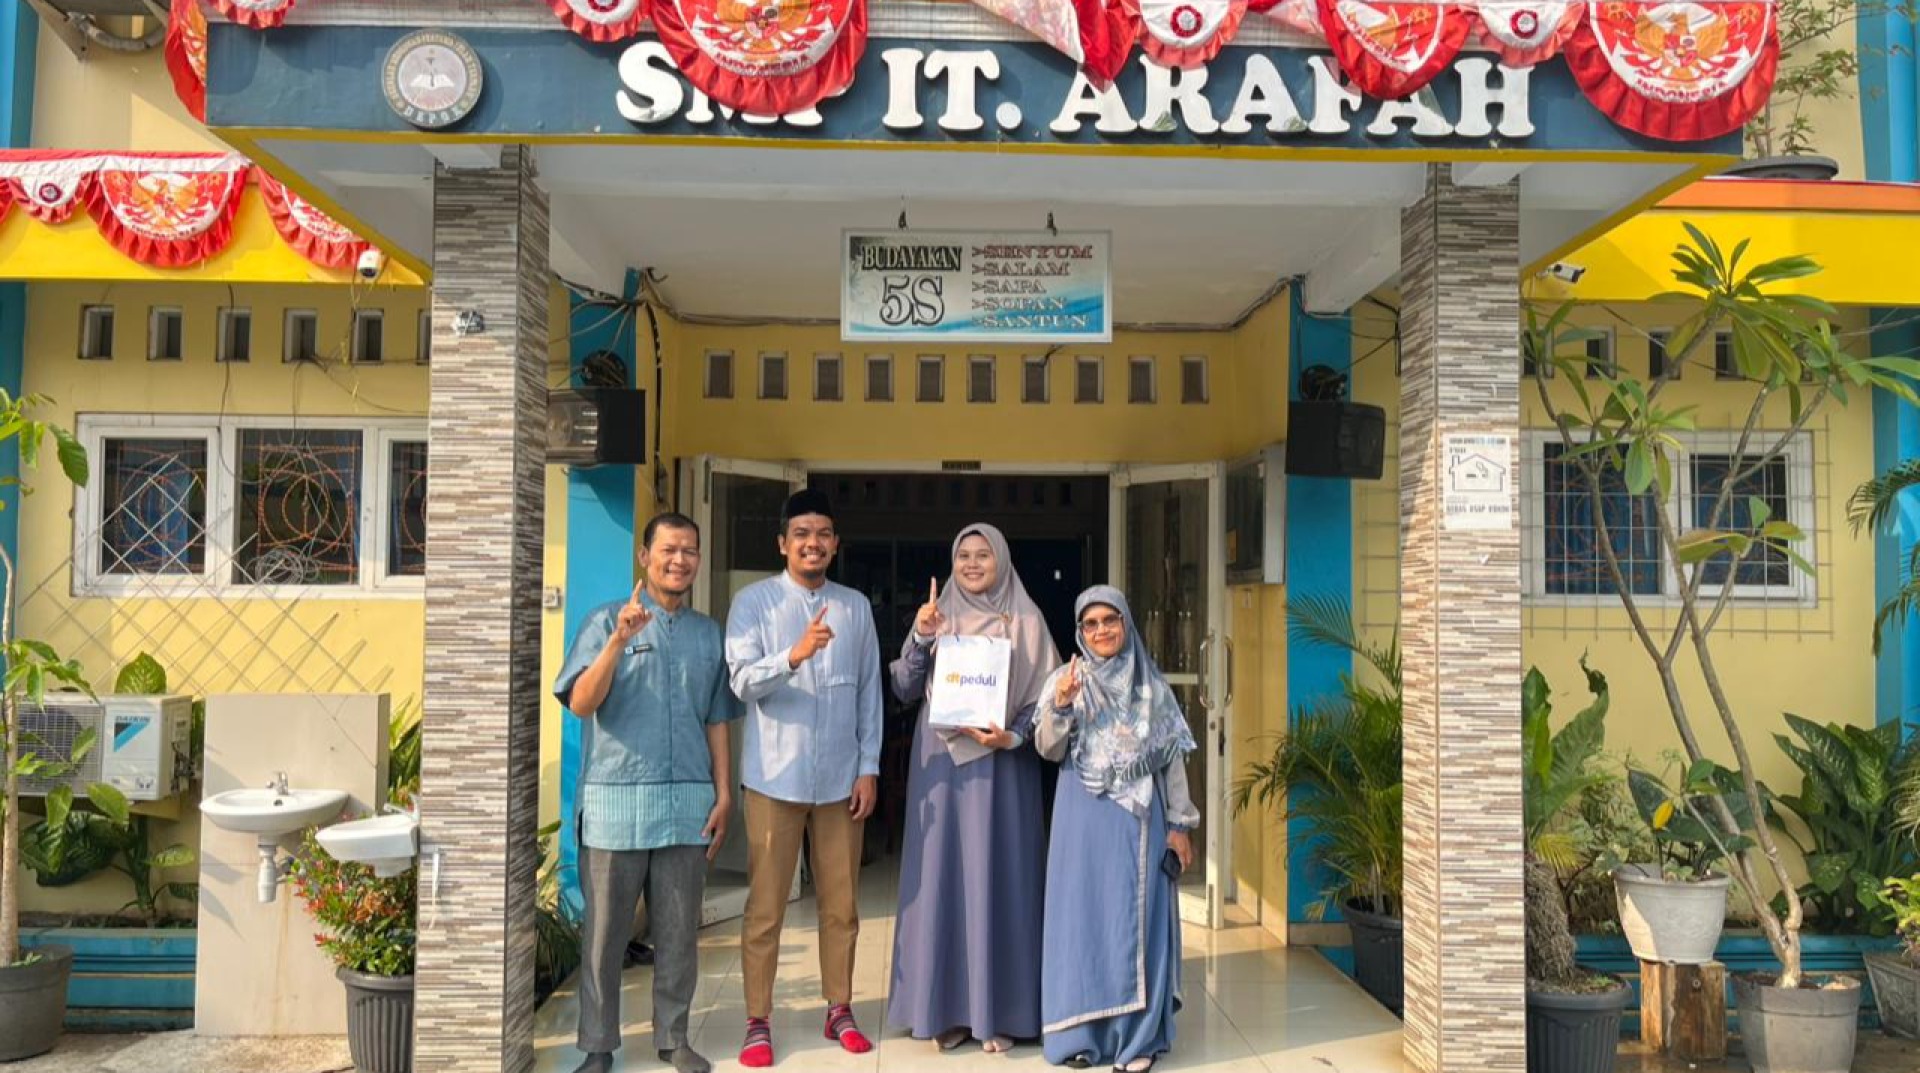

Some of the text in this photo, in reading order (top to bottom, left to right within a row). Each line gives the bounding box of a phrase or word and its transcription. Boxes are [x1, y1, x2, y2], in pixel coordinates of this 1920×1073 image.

[881, 48, 1022, 130] IT.
[862, 245, 962, 270] BUDAYAKAN
[984, 245, 1093, 259] SENYUM
[984, 262, 1070, 276] SALAM
[984, 279, 1047, 294] SAPA
[880, 275, 945, 327] 5S
[984, 297, 1067, 312] SOPAN
[984, 314, 1089, 328] SANTUN
